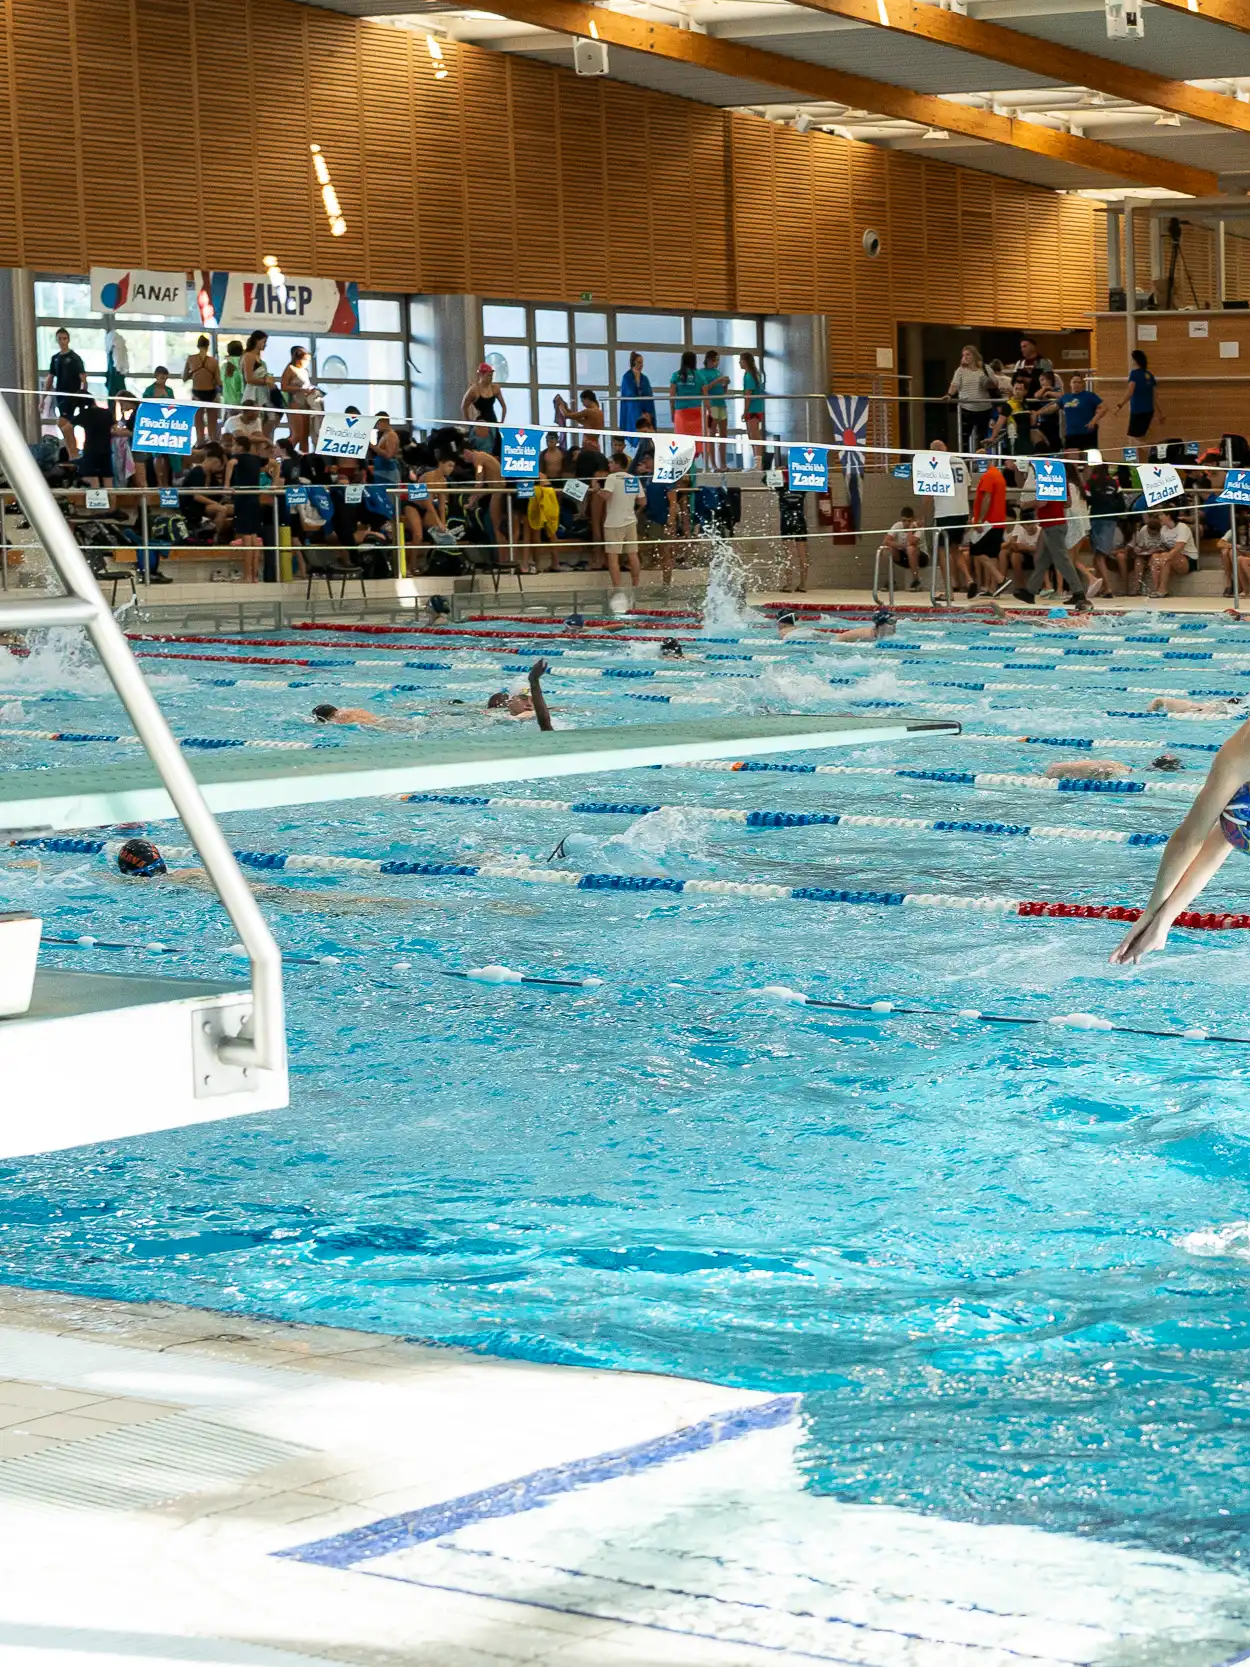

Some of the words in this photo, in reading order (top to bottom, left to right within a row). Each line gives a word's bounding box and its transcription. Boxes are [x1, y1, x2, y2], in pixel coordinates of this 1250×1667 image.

[169, 420, 188, 432] klub
[137, 430, 188, 449] Zadar
[321, 438, 364, 456] Zadar
[503, 456, 537, 472] Zadar
[792, 472, 826, 487] Zadar
[917, 480, 951, 494] Zadar
[1038, 483, 1065, 497] Zadar
[1148, 483, 1179, 504] Zadar
